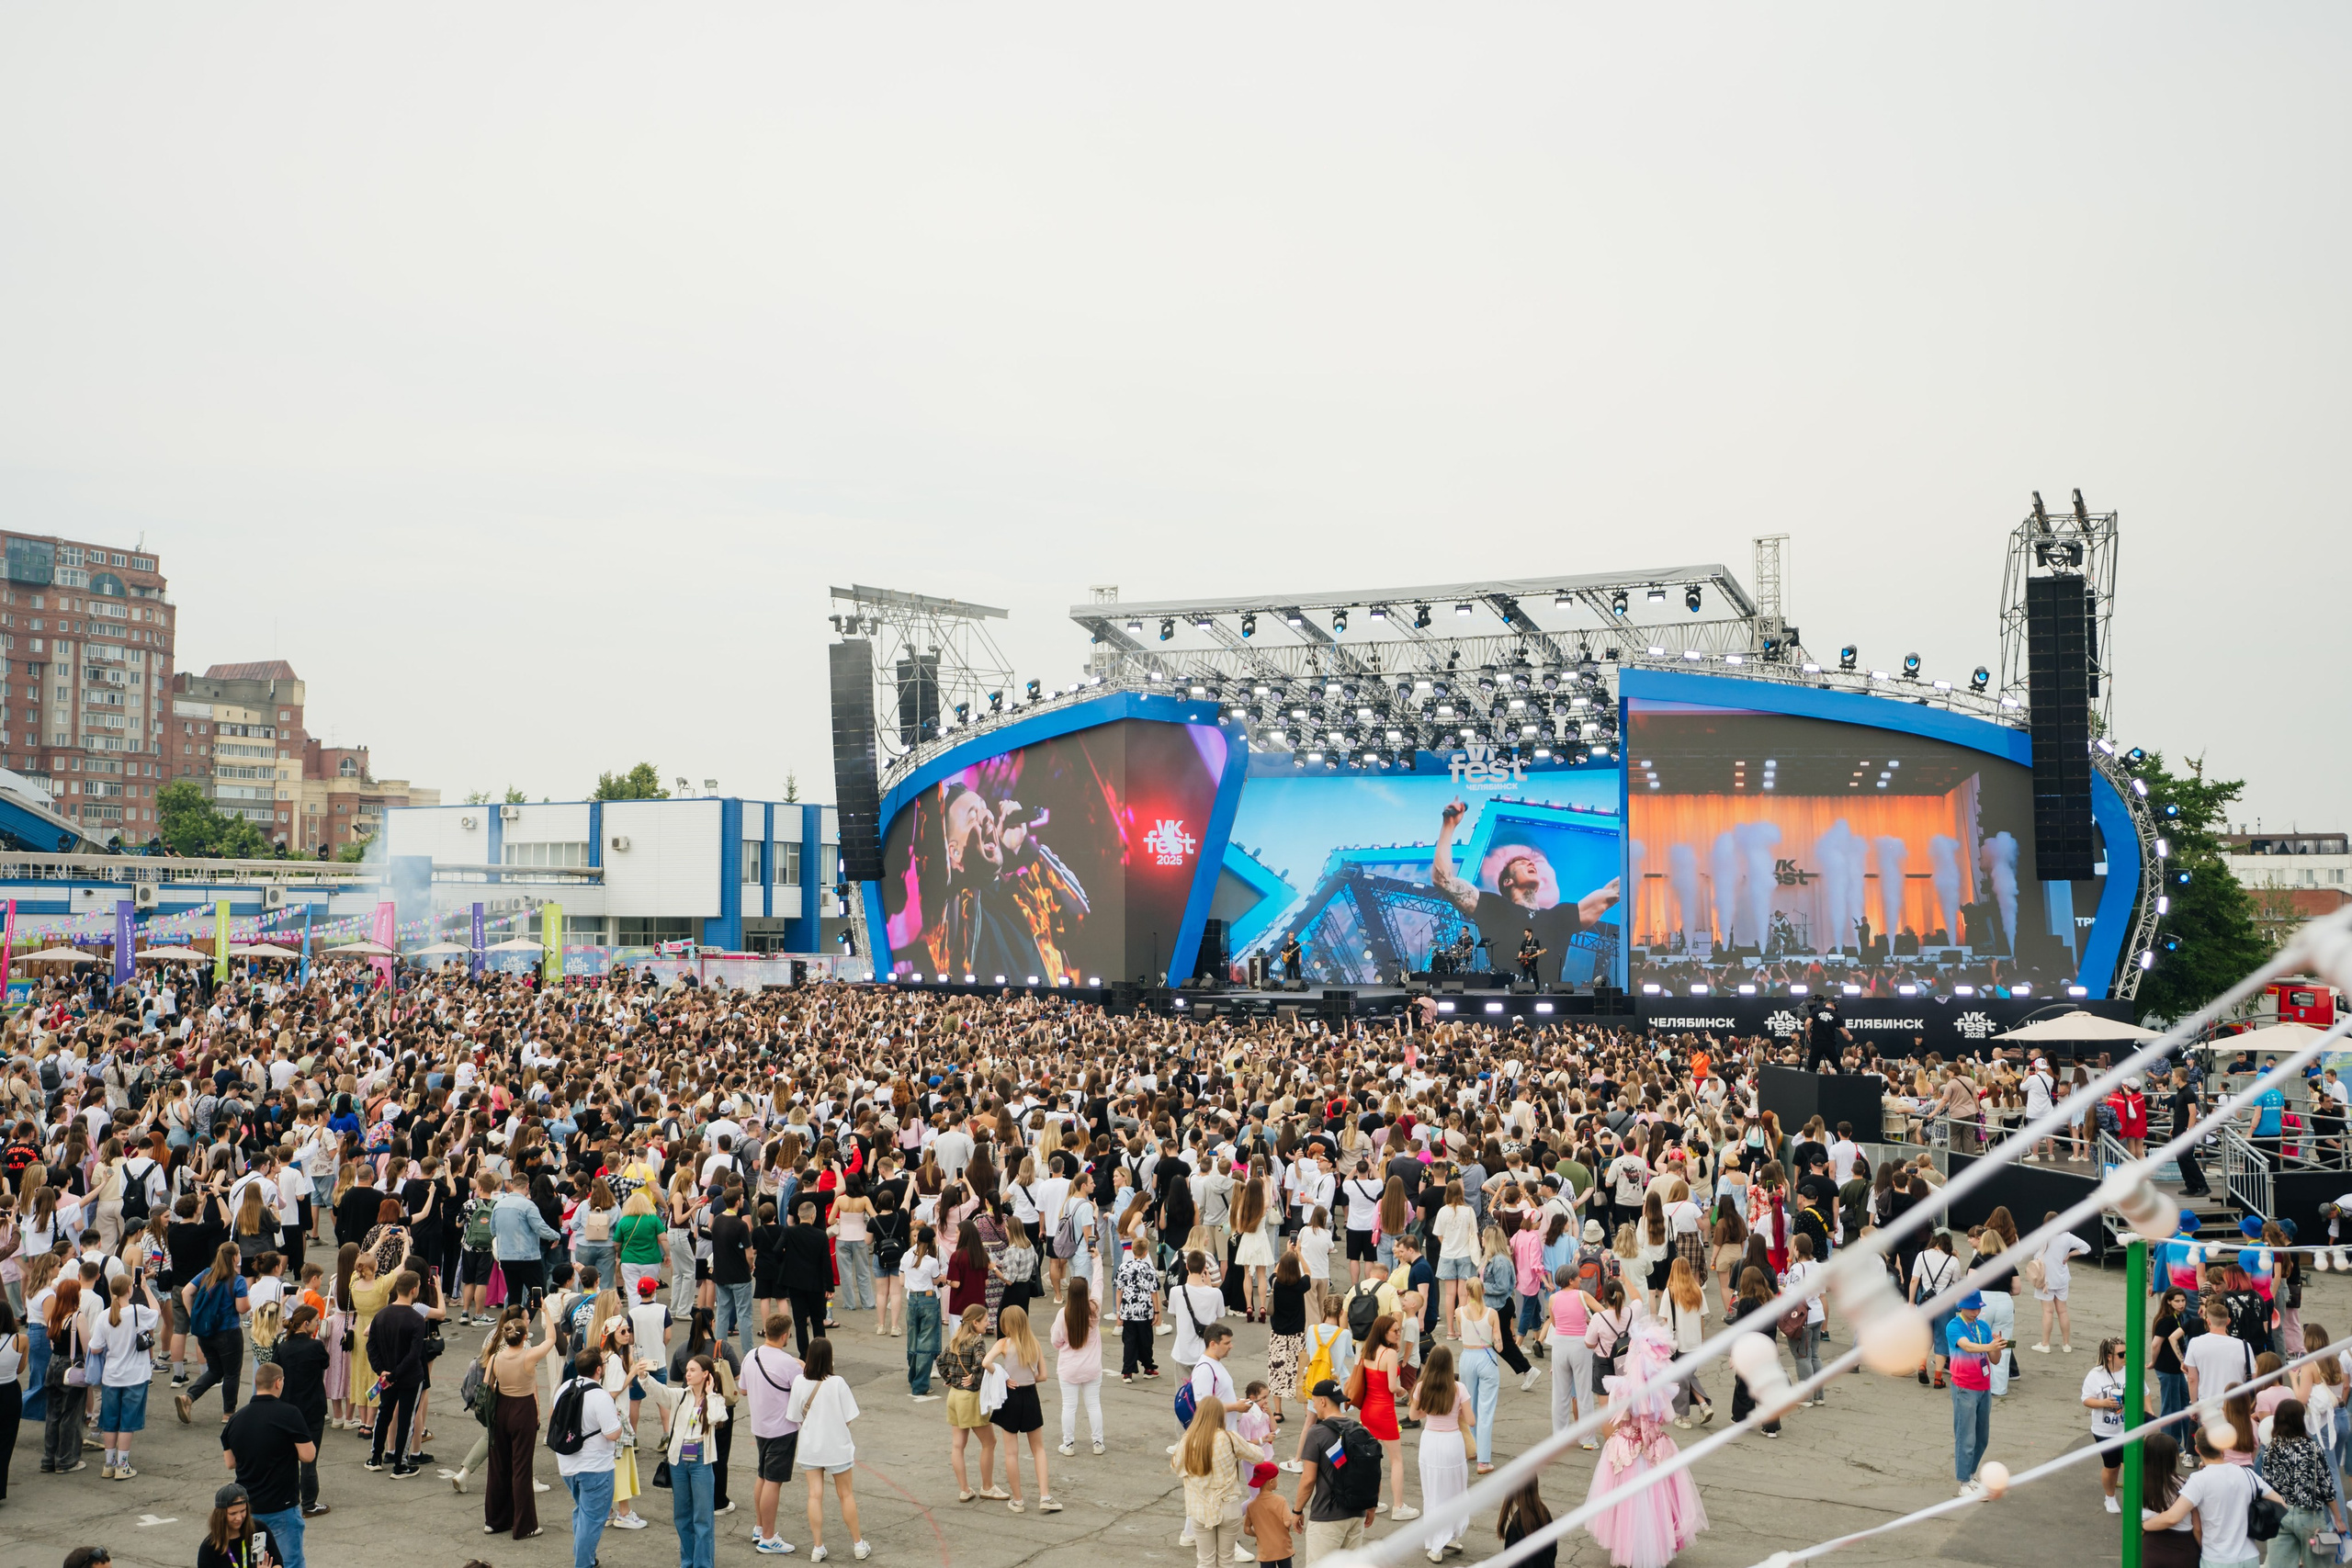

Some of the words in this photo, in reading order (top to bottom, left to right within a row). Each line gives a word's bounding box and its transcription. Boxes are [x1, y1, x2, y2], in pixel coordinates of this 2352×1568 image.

[1448, 754, 1528, 783] fest
[1156, 819, 1184, 836] VK
[1143, 829, 1196, 854] fest
[1157, 855, 1182, 865] 2025
[124, 914, 132, 970] ФУДКОРТ
[502, 961, 526, 970] fest
[565, 963, 590, 972] fest
[1962, 1011, 1987, 1021] VK
[1648, 1017, 1736, 1028] ЧЕЛЯБИНСК
[1764, 1017, 1805, 1031] fest
[1844, 1019, 1924, 1029] ЕЛЯБИНСК
[1953, 1018, 1996, 1032] fest
